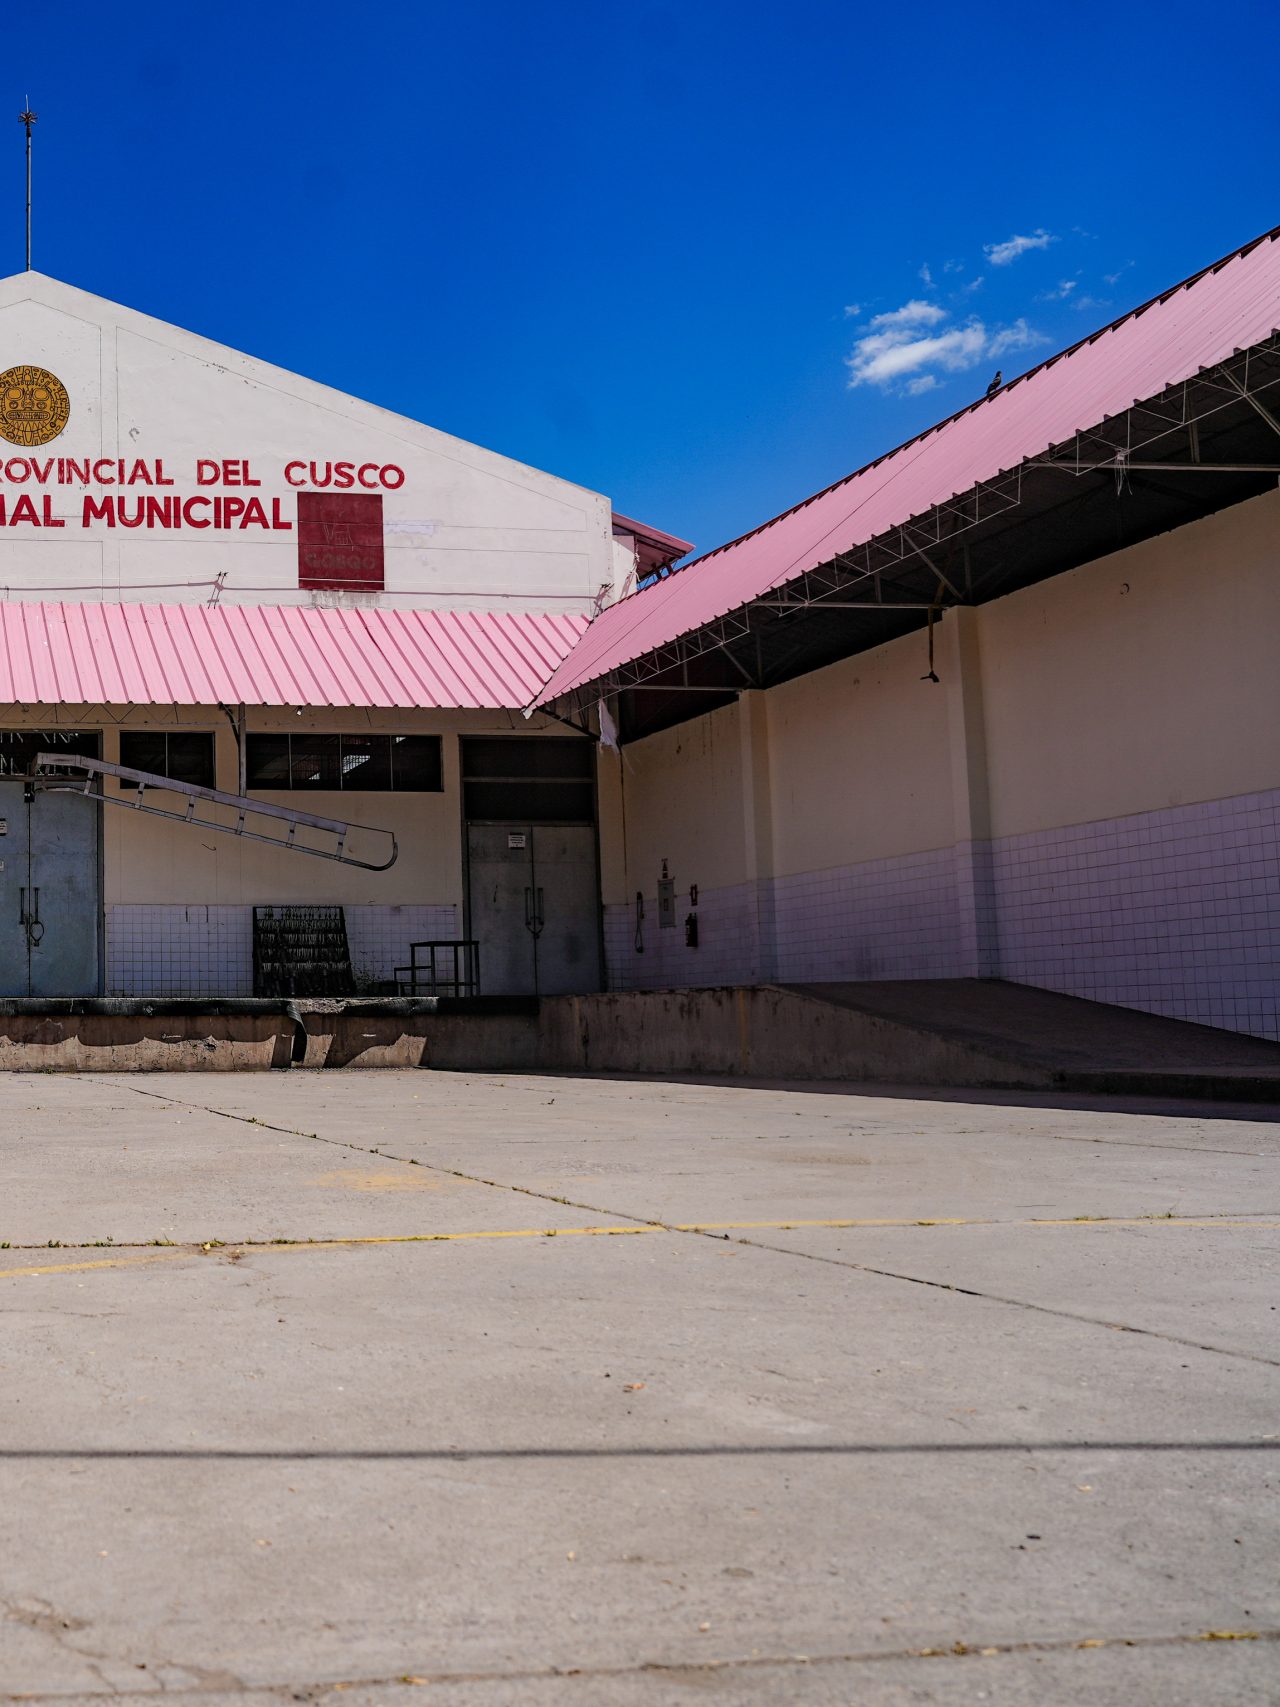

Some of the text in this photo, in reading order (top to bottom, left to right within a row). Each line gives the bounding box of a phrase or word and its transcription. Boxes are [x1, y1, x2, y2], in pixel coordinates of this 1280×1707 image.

[196, 460, 261, 486] DEL
[284, 461, 405, 490] CUSCO
[82, 496, 293, 530] MUNICIPAL
